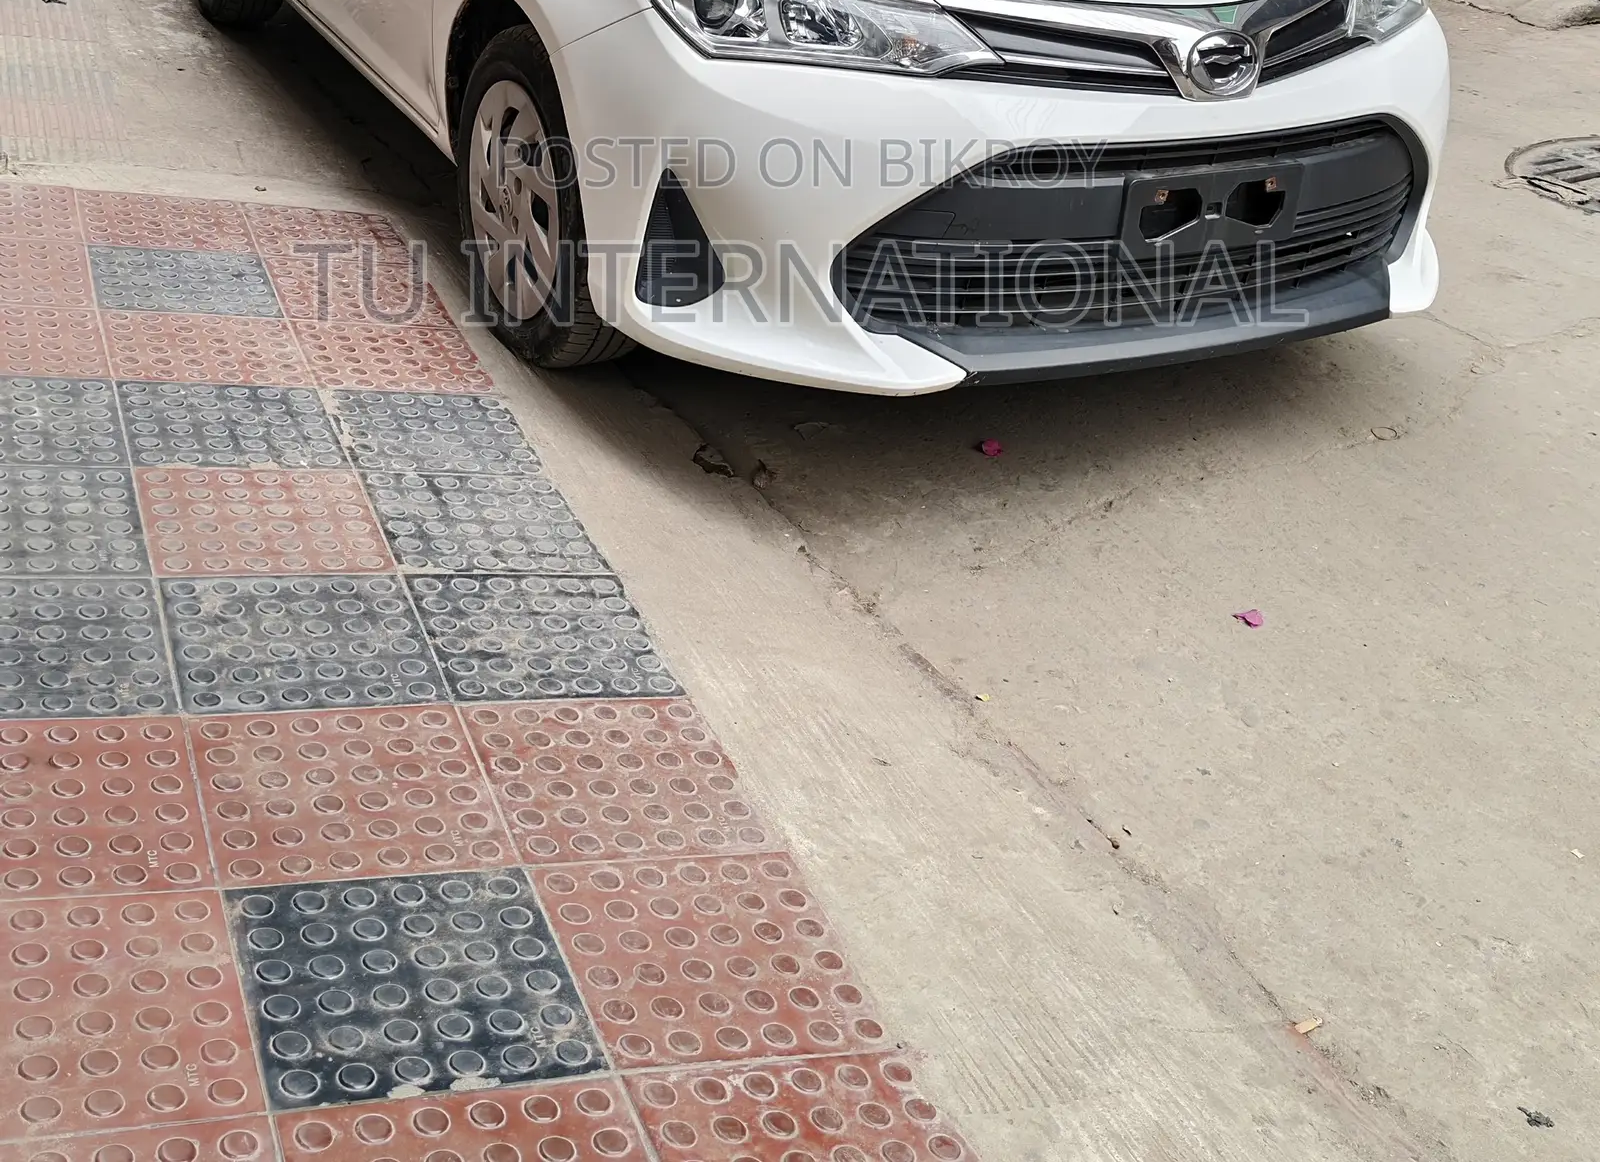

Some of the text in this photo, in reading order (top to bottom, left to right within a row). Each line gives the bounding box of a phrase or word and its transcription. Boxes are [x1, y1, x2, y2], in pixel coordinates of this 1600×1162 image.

[390, 673, 402, 687] MTC
[450, 829, 463, 847] MTC
[146, 849, 159, 868] MTC
[185, 1063, 201, 1087] MTC
